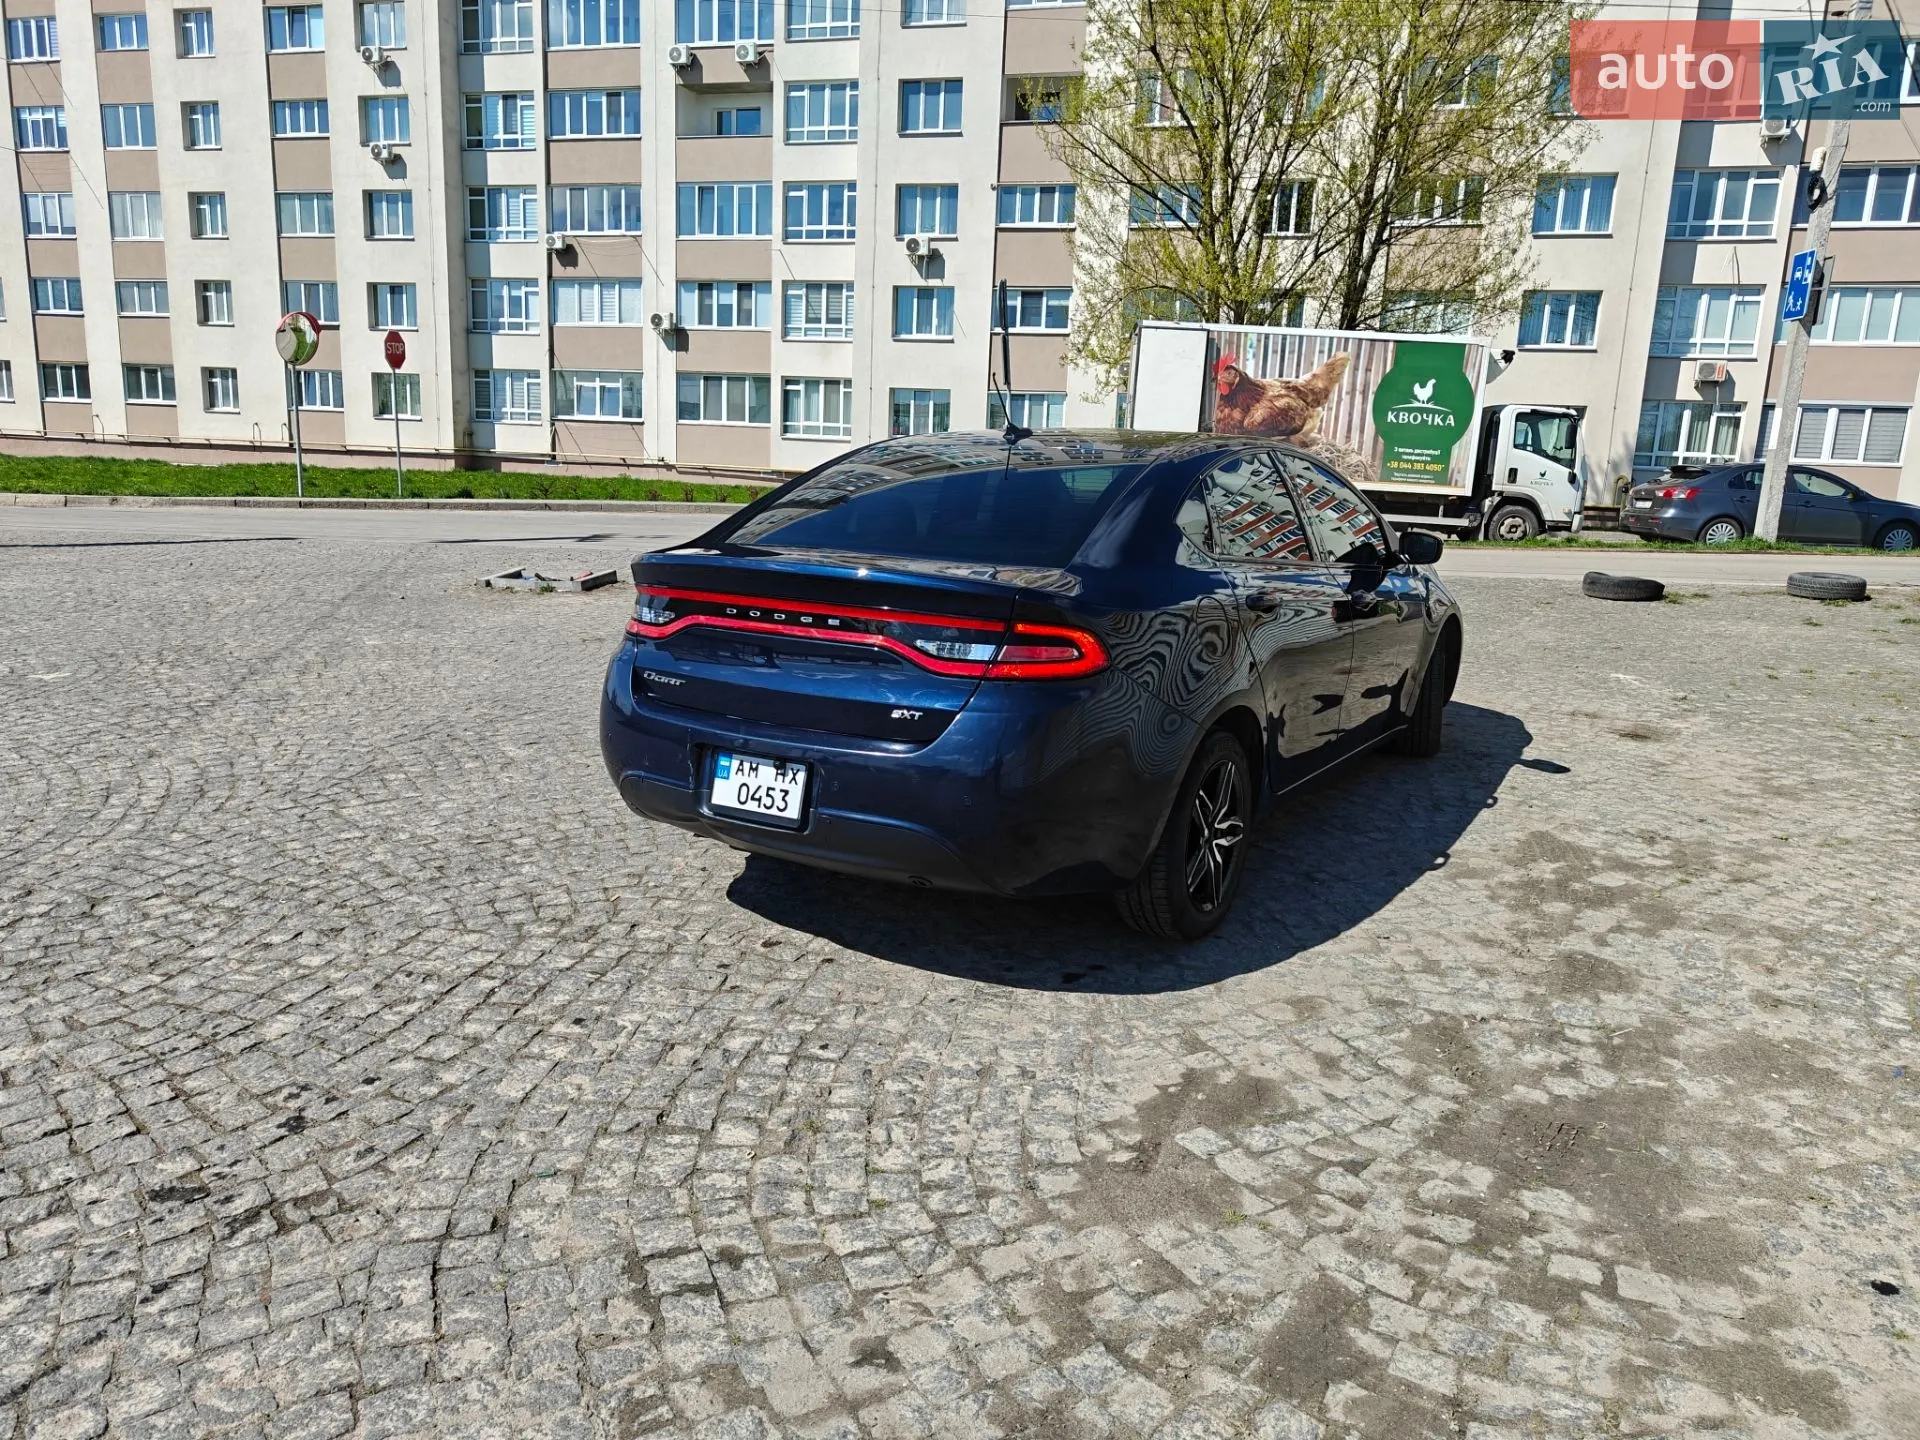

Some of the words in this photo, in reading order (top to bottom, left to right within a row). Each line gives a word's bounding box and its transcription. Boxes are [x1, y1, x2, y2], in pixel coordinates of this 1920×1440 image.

[387, 342, 404, 354] STOP
[1387, 411, 1455, 427] КВОЧКА
[726, 607, 840, 626] DODGE
[891, 709, 923, 720] SXT
[718, 769, 728, 778] UA
[737, 782, 789, 812] 0453
